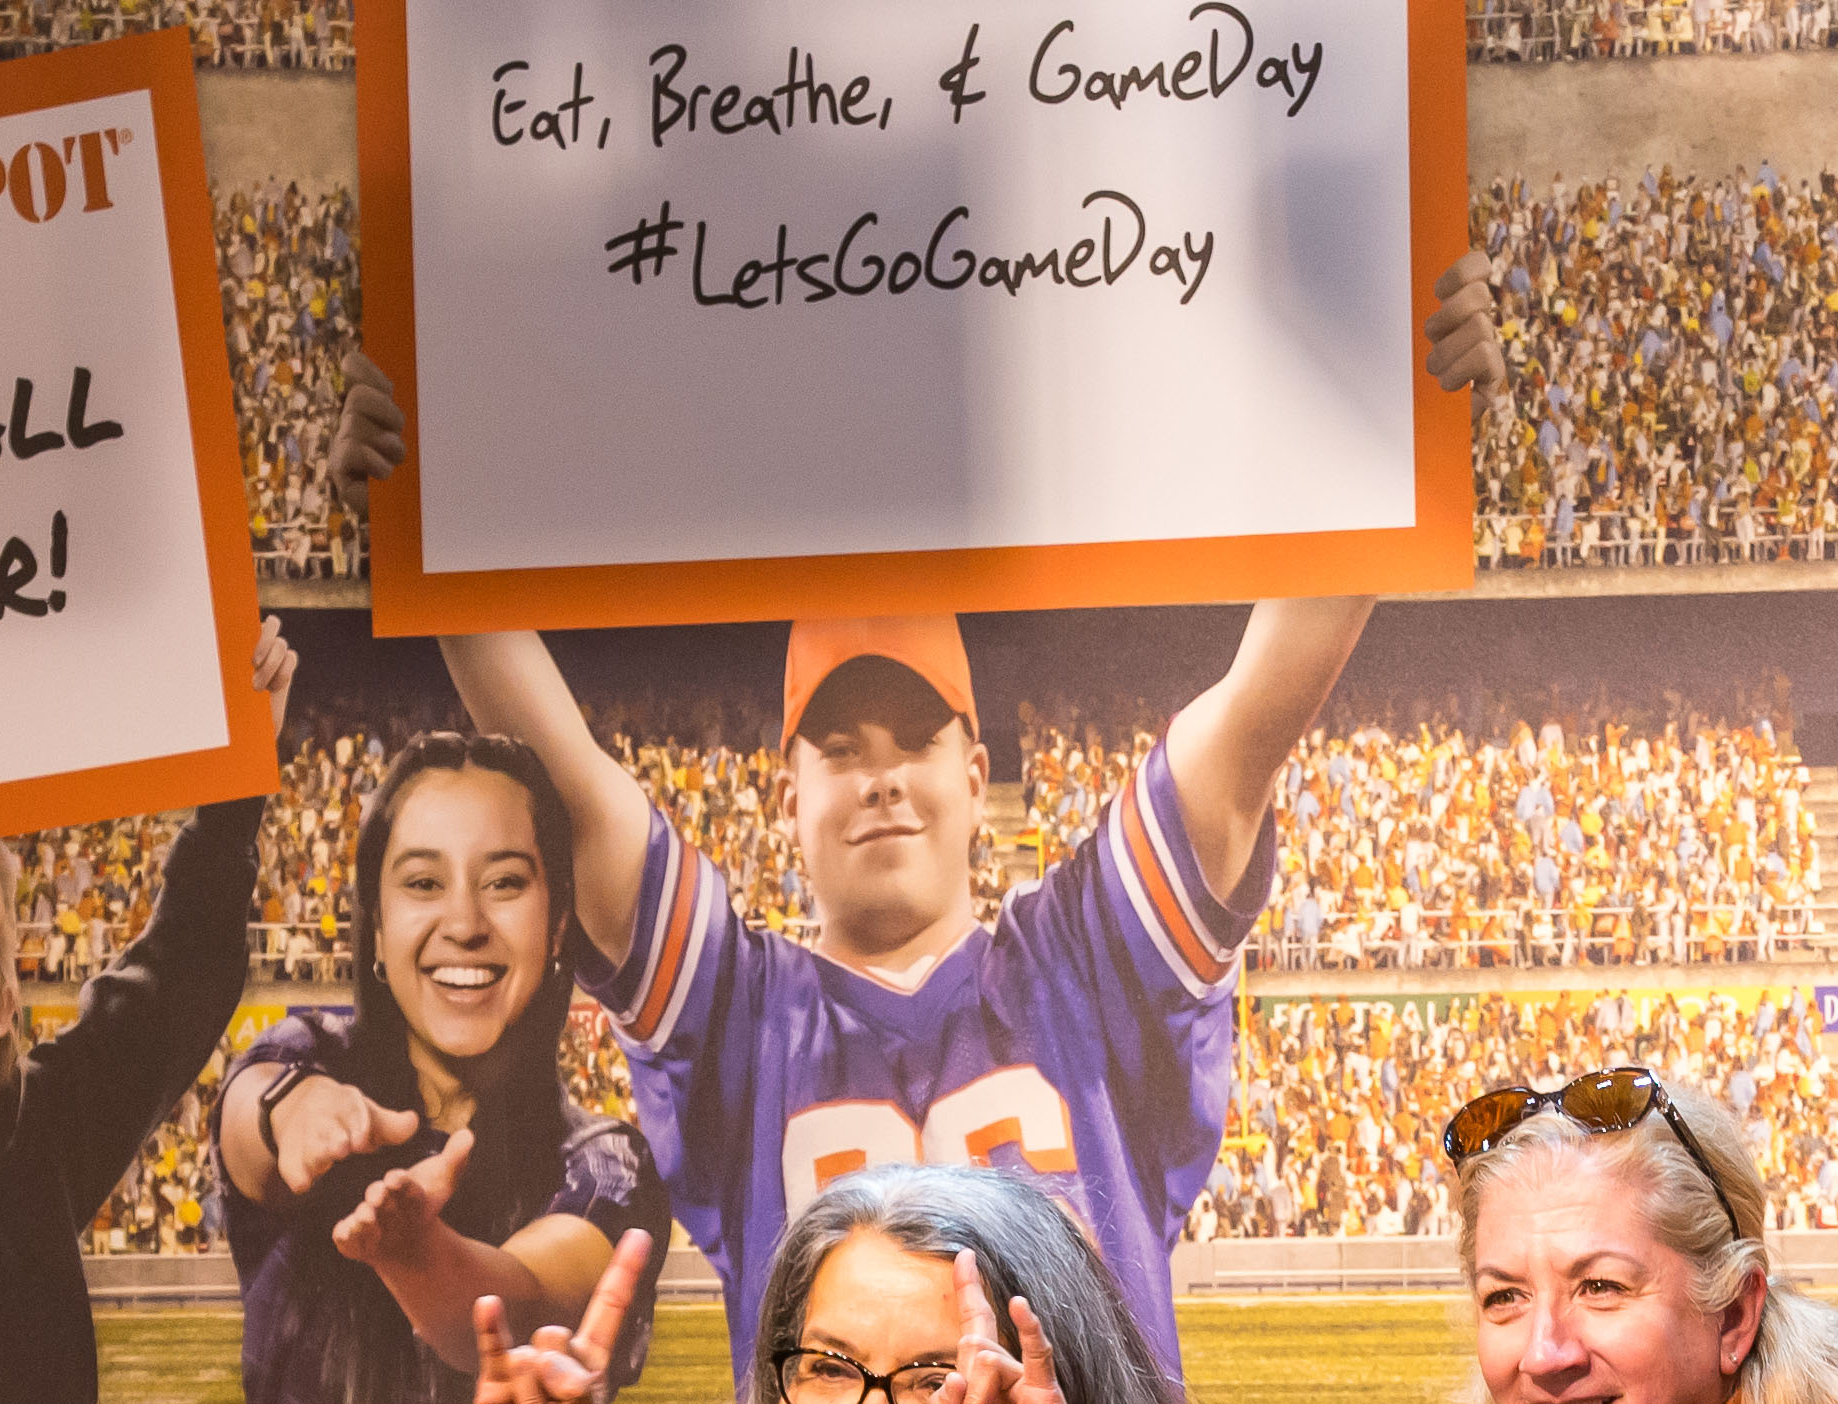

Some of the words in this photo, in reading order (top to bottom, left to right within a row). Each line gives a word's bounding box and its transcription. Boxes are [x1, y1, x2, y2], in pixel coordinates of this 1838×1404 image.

[492, 60, 611, 150] Eat,
[649, 43, 893, 148] Breathe,
[1029, 2, 1323, 118] GameDay
[603, 190, 1215, 310] #LetsGoGameDay
